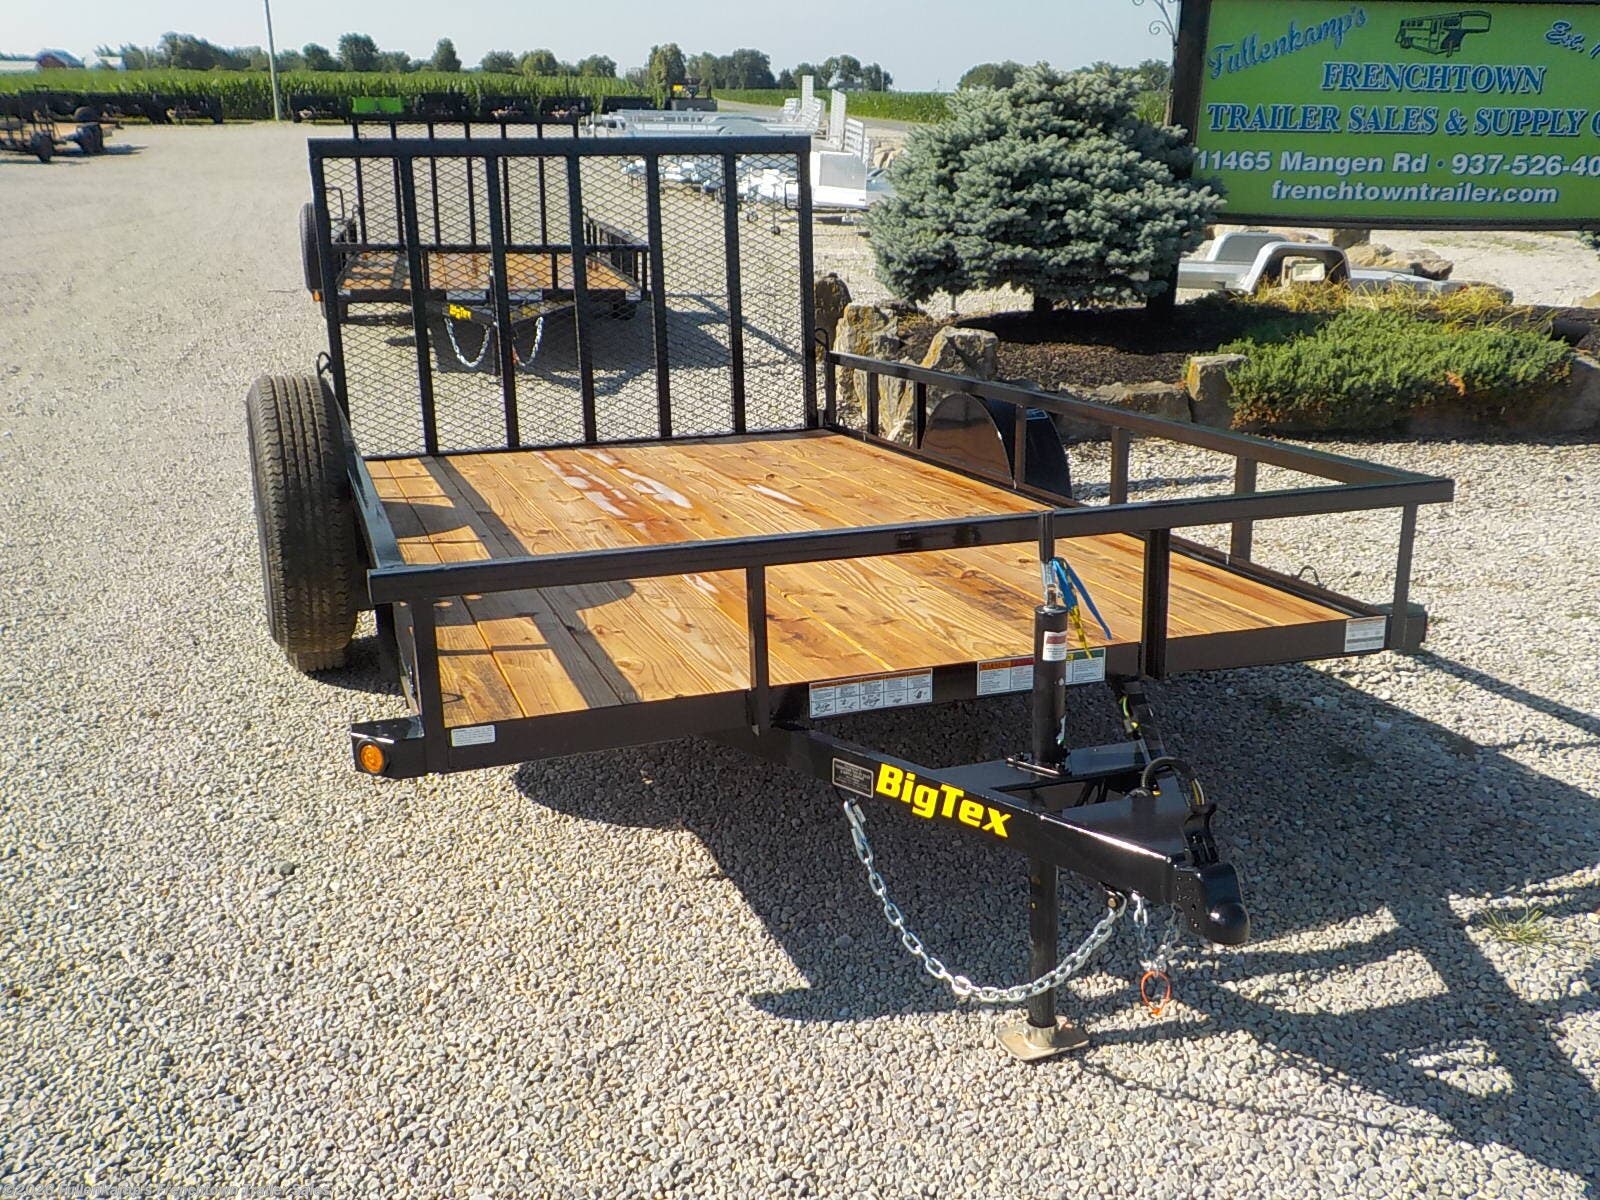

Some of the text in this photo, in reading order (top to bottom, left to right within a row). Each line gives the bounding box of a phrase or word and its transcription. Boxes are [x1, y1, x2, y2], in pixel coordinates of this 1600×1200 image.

[1208, 6, 1367, 79] Fullenkamp's
[1320, 62, 1547, 95] FRENCHTOWN
[1207, 103, 1342, 133] TRAILER
[1348, 106, 1438, 136] SALES
[1445, 109, 1467, 135] &
[1473, 108, 1588, 137] SUPPLY
[1199, 150, 1271, 171] 11465
[1280, 151, 1383, 177] Mangen
[1393, 154, 1426, 173] Rd
[1272, 180, 1557, 203] frenchtowntrailer.com
[876, 762, 1012, 838] BigTex
